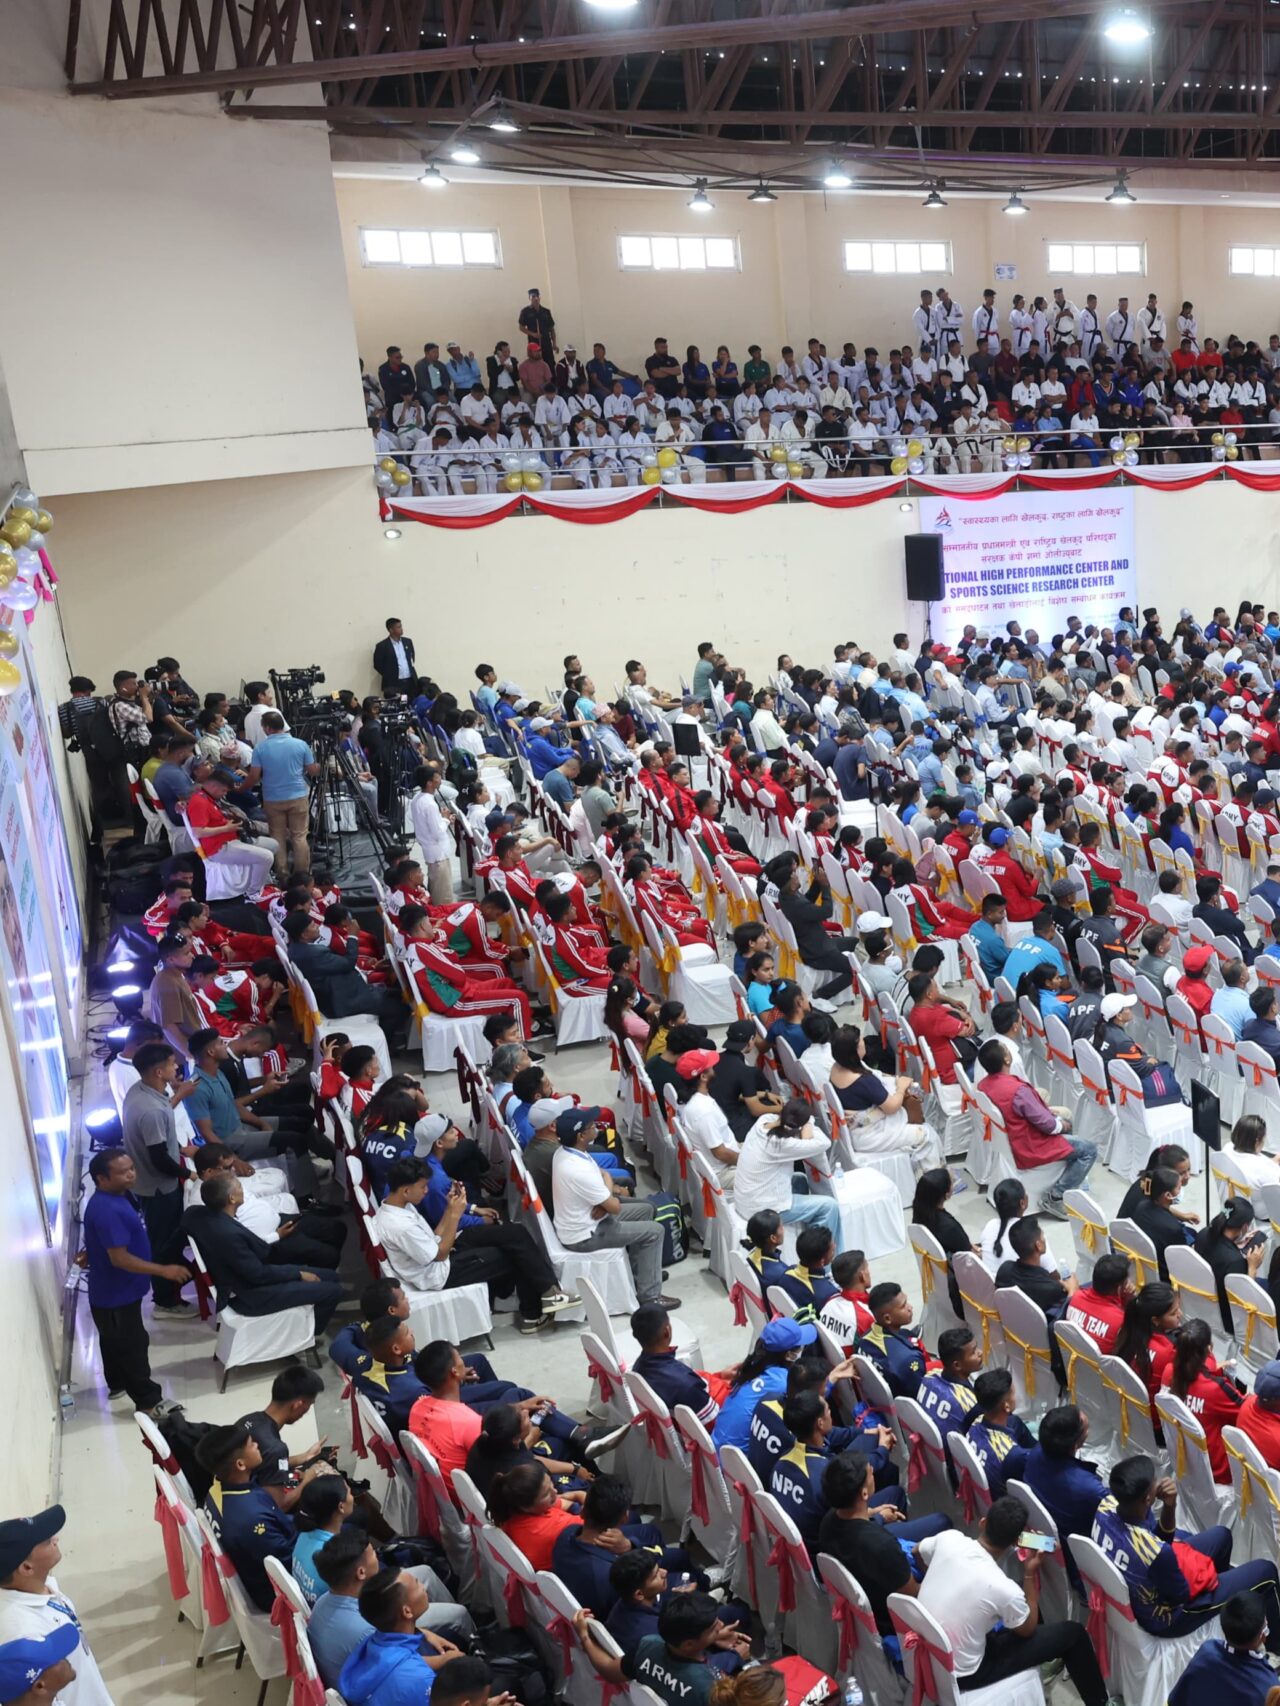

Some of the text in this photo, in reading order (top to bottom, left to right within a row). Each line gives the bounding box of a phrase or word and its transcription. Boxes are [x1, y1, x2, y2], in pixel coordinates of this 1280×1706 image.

[944, 559, 1129, 584] TIONAL HIGH PERFORMANCE CENTER AND
[950, 575, 1114, 599] SPORTS SCIENCE RESEARCH CENTER
[1080, 927, 1100, 943] APF
[1014, 941, 1042, 955] APF
[1069, 1004, 1096, 1019] APF
[366, 1140, 397, 1159] NPC
[820, 1313, 852, 1339] ARMY
[1085, 1315, 1110, 1339] TEAM
[916, 1383, 952, 1420] NPC
[750, 1414, 782, 1454] NPC
[771, 1470, 805, 1504] NPC
[639, 1658, 693, 1698] ARMY
